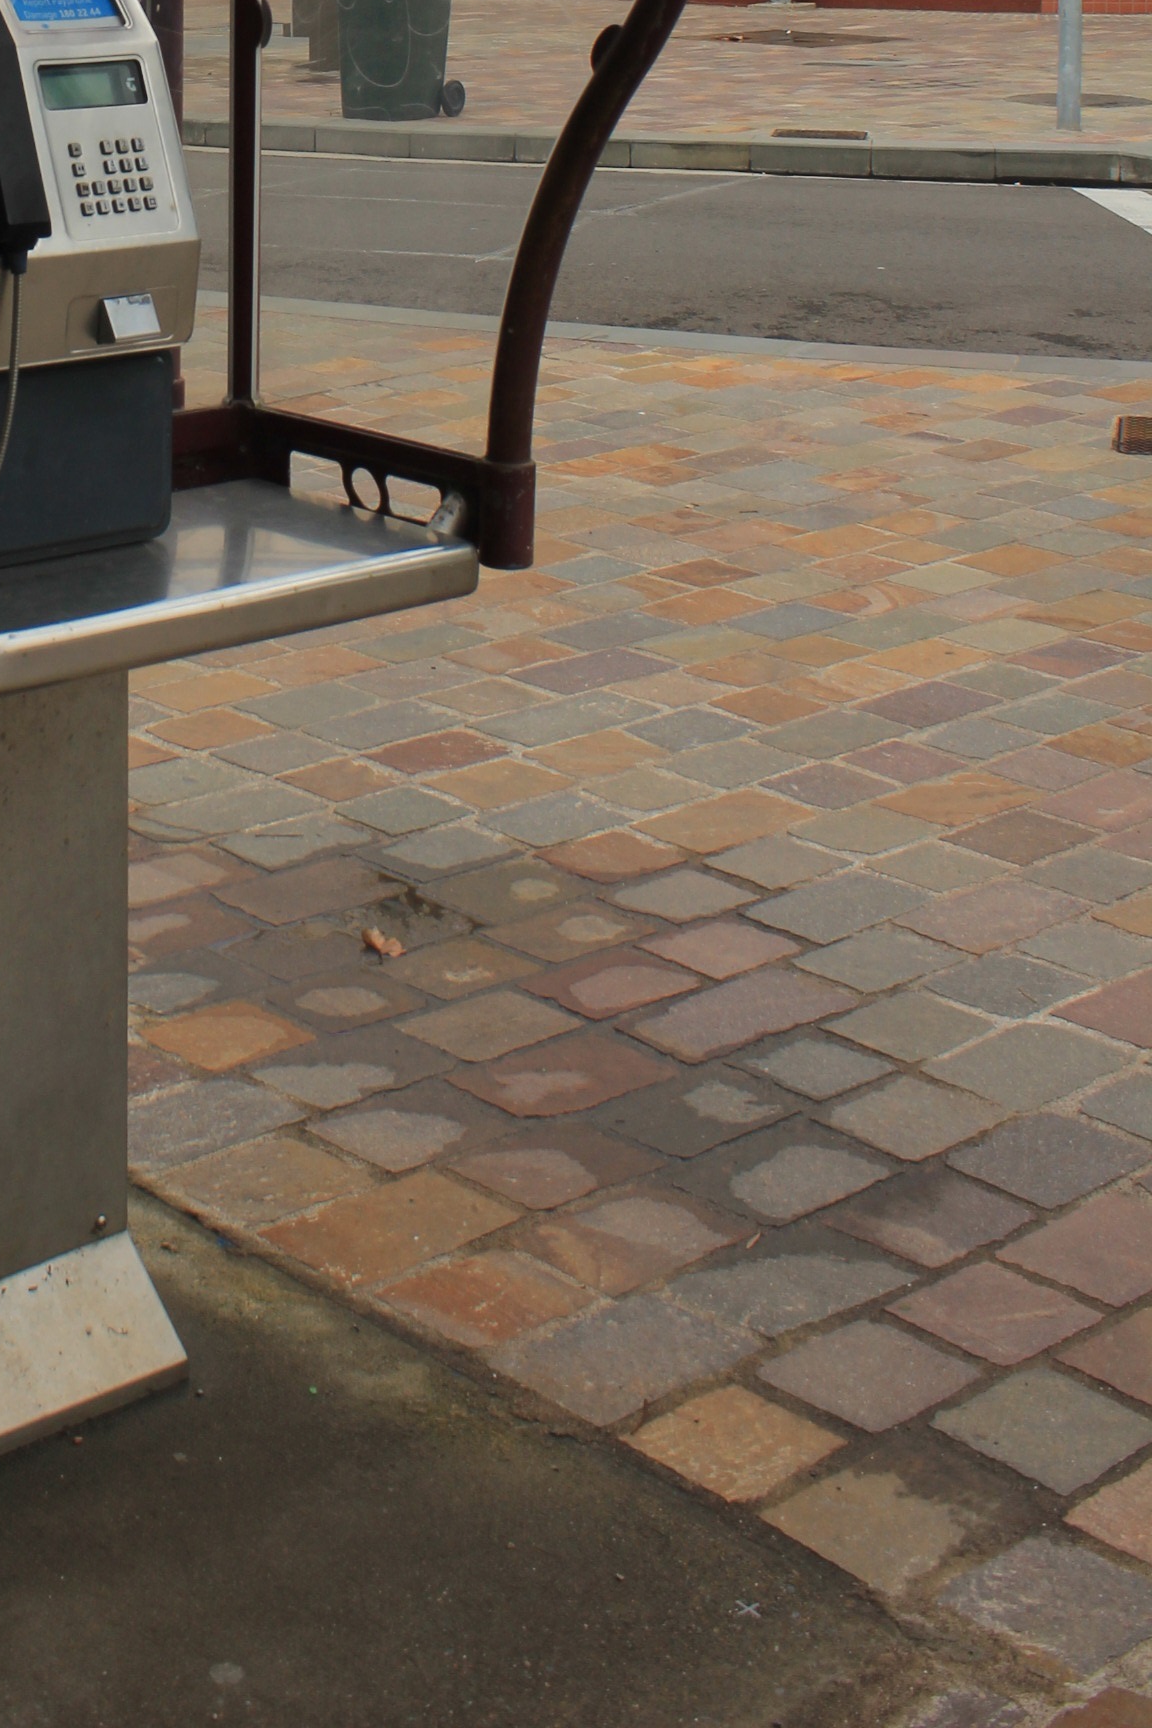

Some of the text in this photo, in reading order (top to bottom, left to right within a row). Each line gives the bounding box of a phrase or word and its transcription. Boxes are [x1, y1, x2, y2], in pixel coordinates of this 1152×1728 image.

[23, 6, 101, 20] Damage 180 22 44
